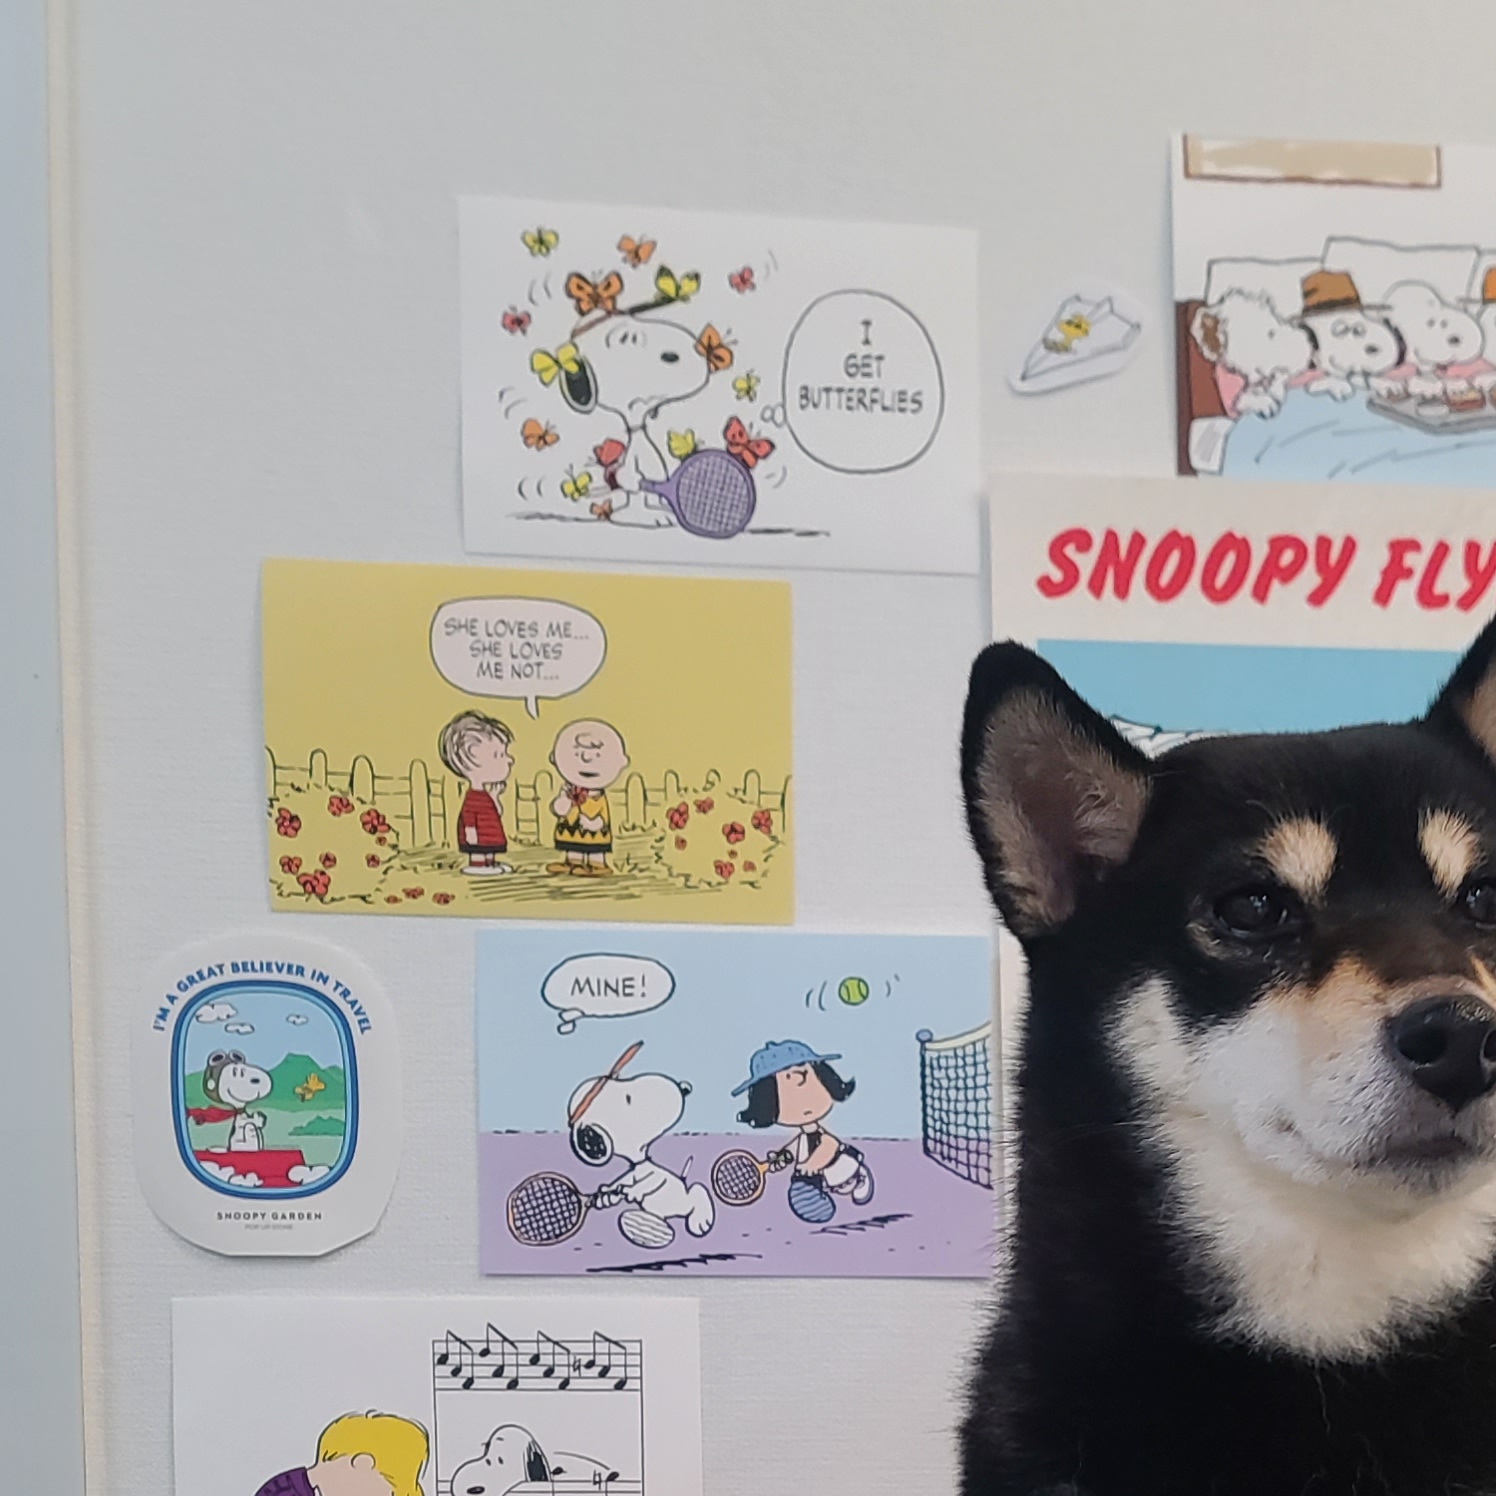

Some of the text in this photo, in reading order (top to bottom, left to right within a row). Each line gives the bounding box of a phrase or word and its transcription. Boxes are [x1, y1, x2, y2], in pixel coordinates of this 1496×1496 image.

[860, 319, 872, 346] I
[843, 353, 885, 378] GET
[798, 385, 923, 414] BUTTERFLIES
[1036, 528, 1356, 608] SNOOPY
[444, 617, 478, 638] SHE
[485, 619, 538, 639] LOVES
[469, 640, 563, 661] SHE LOVES
[476, 661, 504, 680] ME
[165, 993, 179, 1006] A
[176, 962, 225, 993] GREAT
[230, 959, 306, 979] BELIEVER
[310, 968, 330, 986] IN
[332, 979, 372, 1035] TRAVEL
[571, 973, 647, 998] MINE!
[217, 1211, 323, 1222] SNOOPY GARDEN
